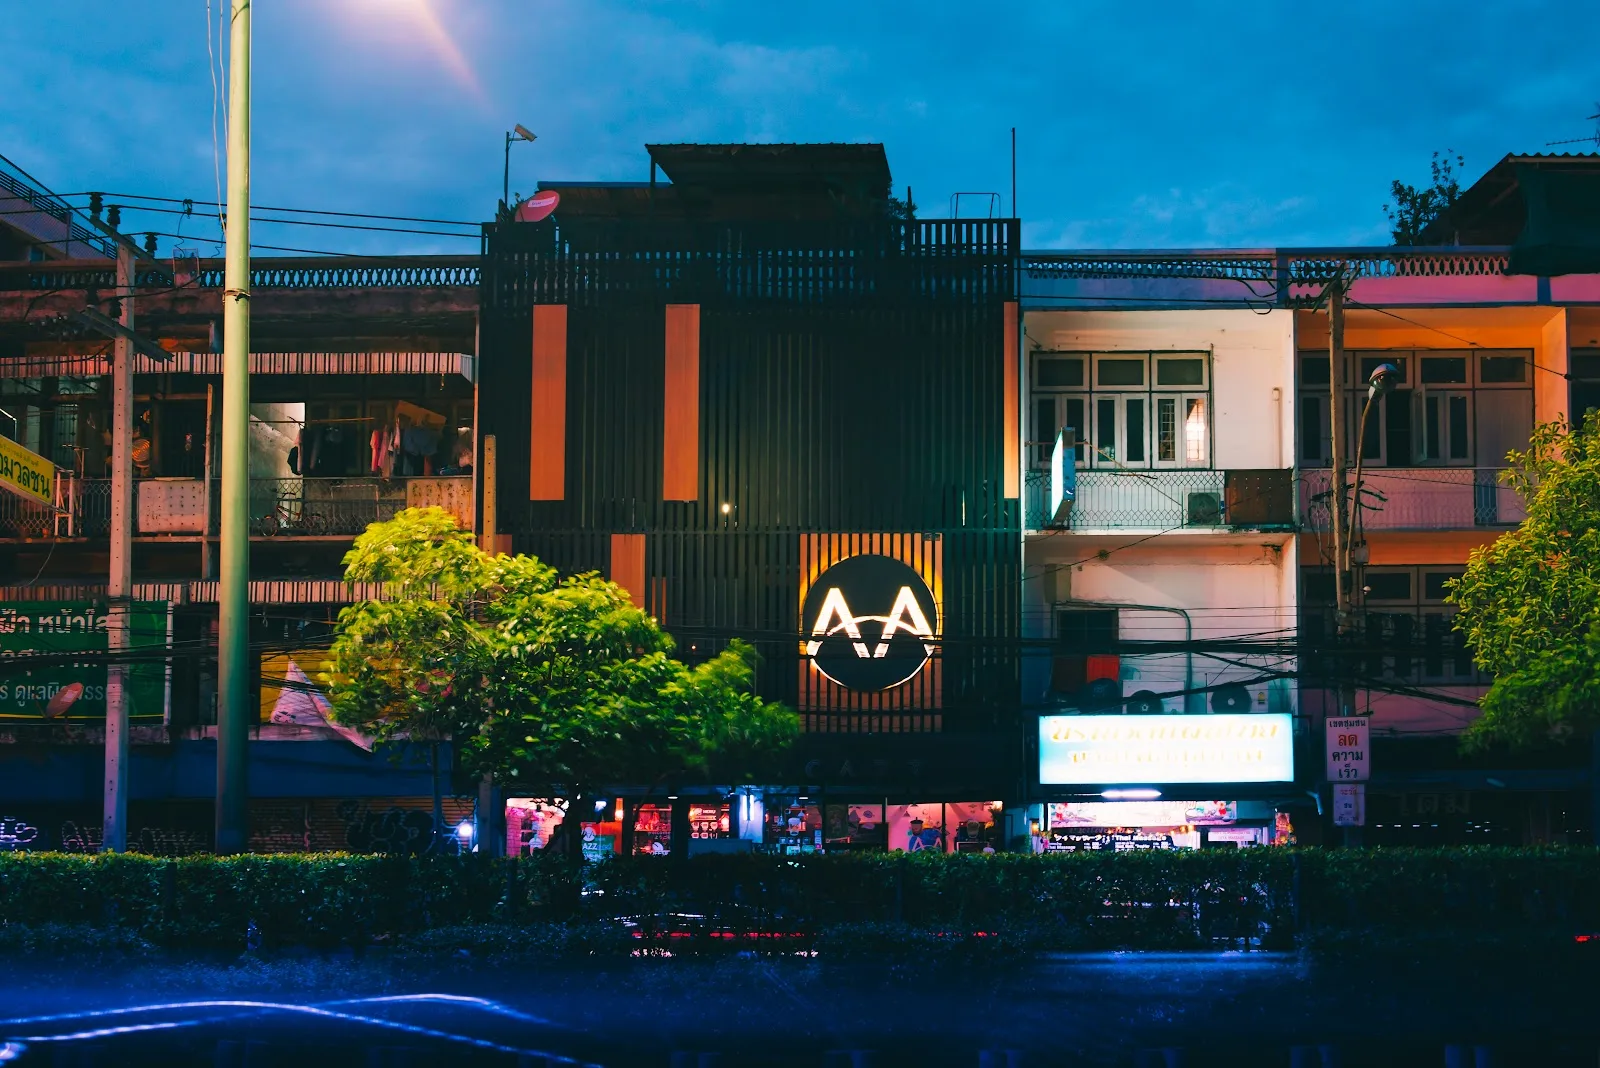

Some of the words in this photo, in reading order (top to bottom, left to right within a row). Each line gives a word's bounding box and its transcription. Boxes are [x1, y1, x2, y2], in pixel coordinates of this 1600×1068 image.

[1329, 719, 1366, 730] เขตชุมชน
[1338, 734, 1358, 747] ลด
[1332, 751, 1363, 762] ความ
[1338, 763, 1358, 778] เร็ว
